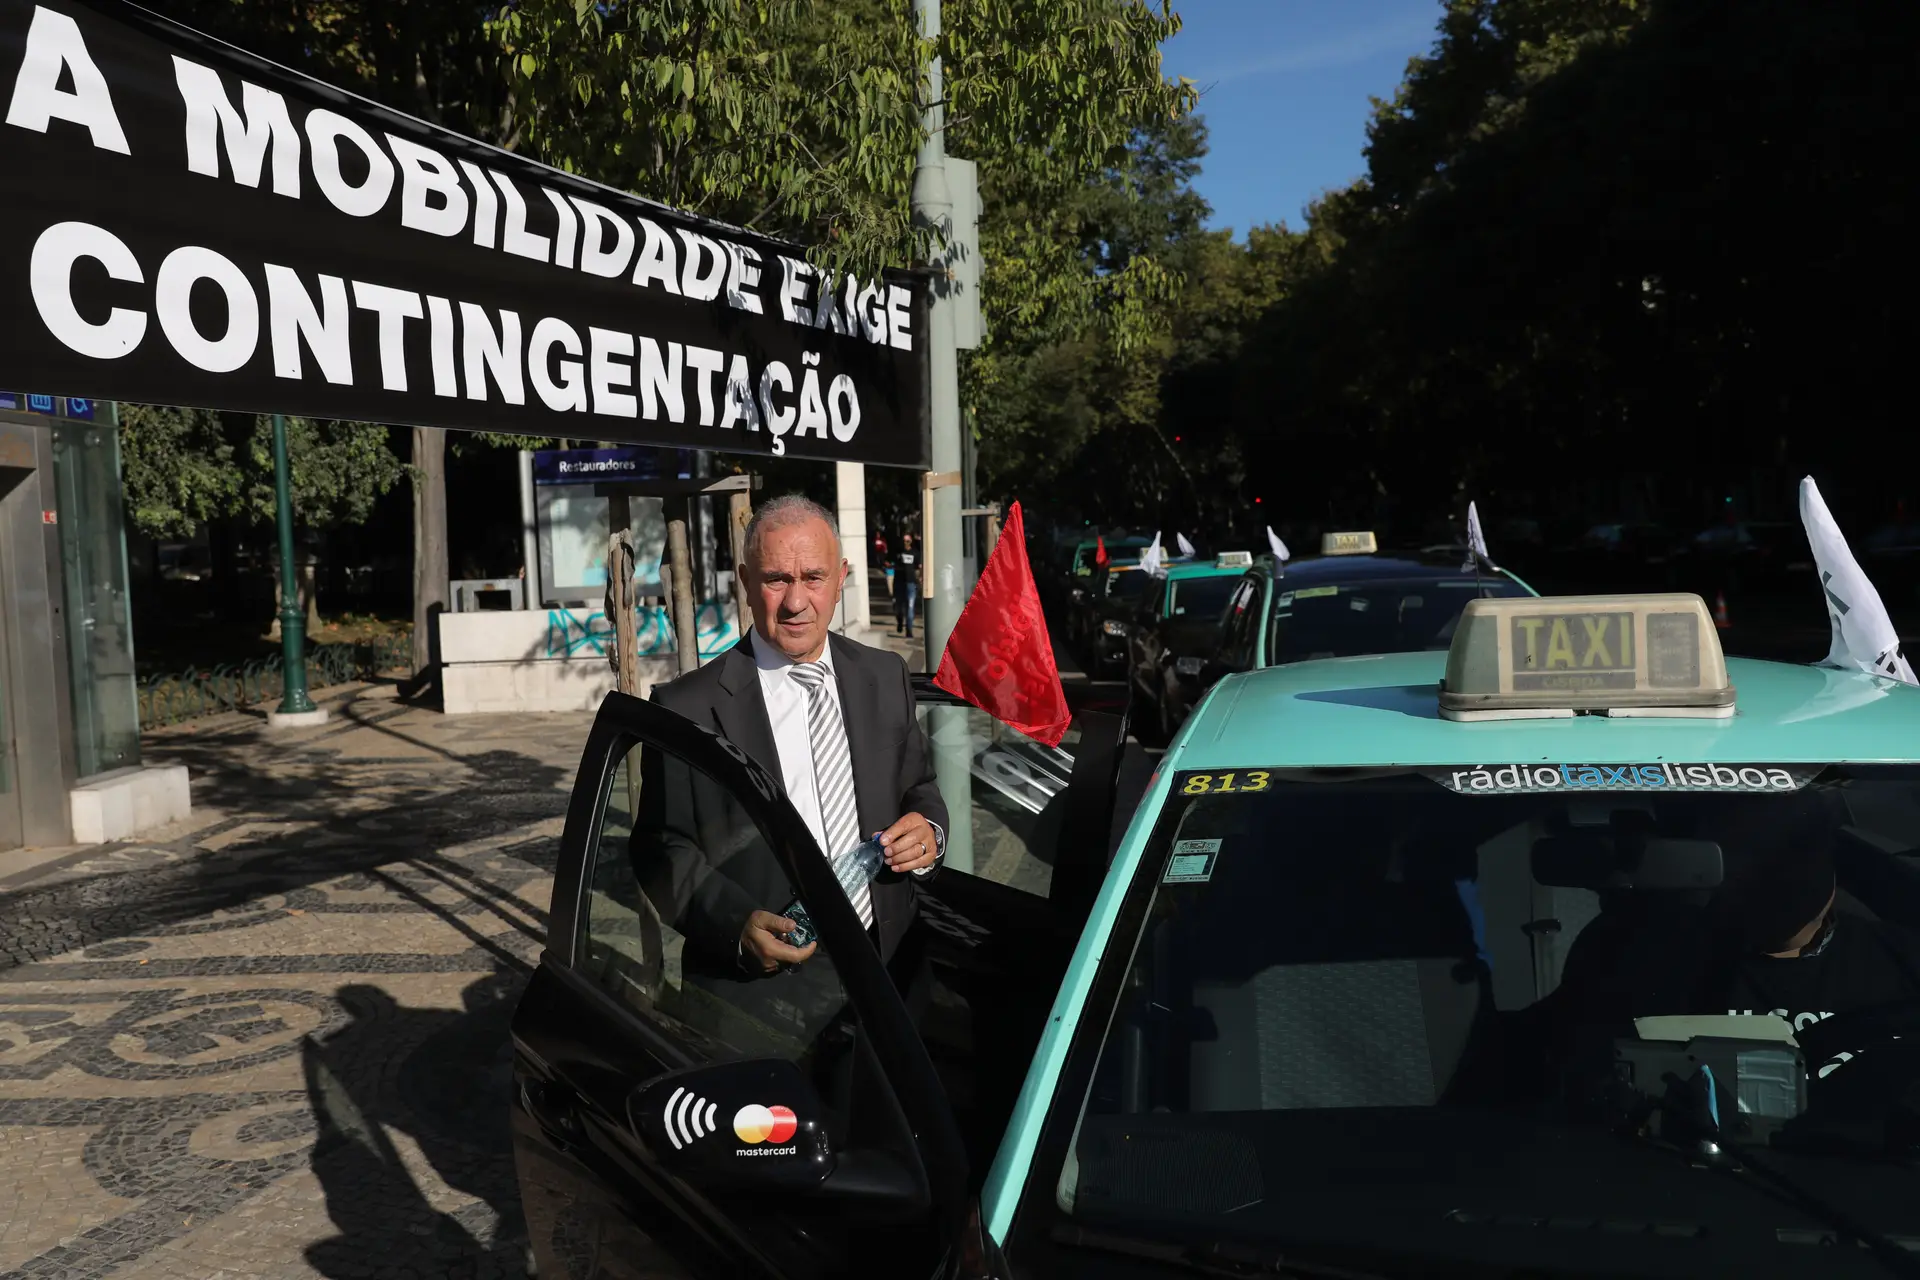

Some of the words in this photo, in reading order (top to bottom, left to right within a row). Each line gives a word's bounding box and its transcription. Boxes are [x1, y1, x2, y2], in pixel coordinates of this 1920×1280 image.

[5, 4, 132, 156] A
[171, 54, 763, 315] MOBILIDADE
[777, 254, 912, 351] EXIGE
[30, 221, 861, 456] CONTINGENTAÇÃO
[559, 459, 636, 472] Restauradores
[1517, 614, 1632, 669] TAXI
[1183, 771, 1270, 794] 813
[736, 1145, 796, 1156] mastercard
